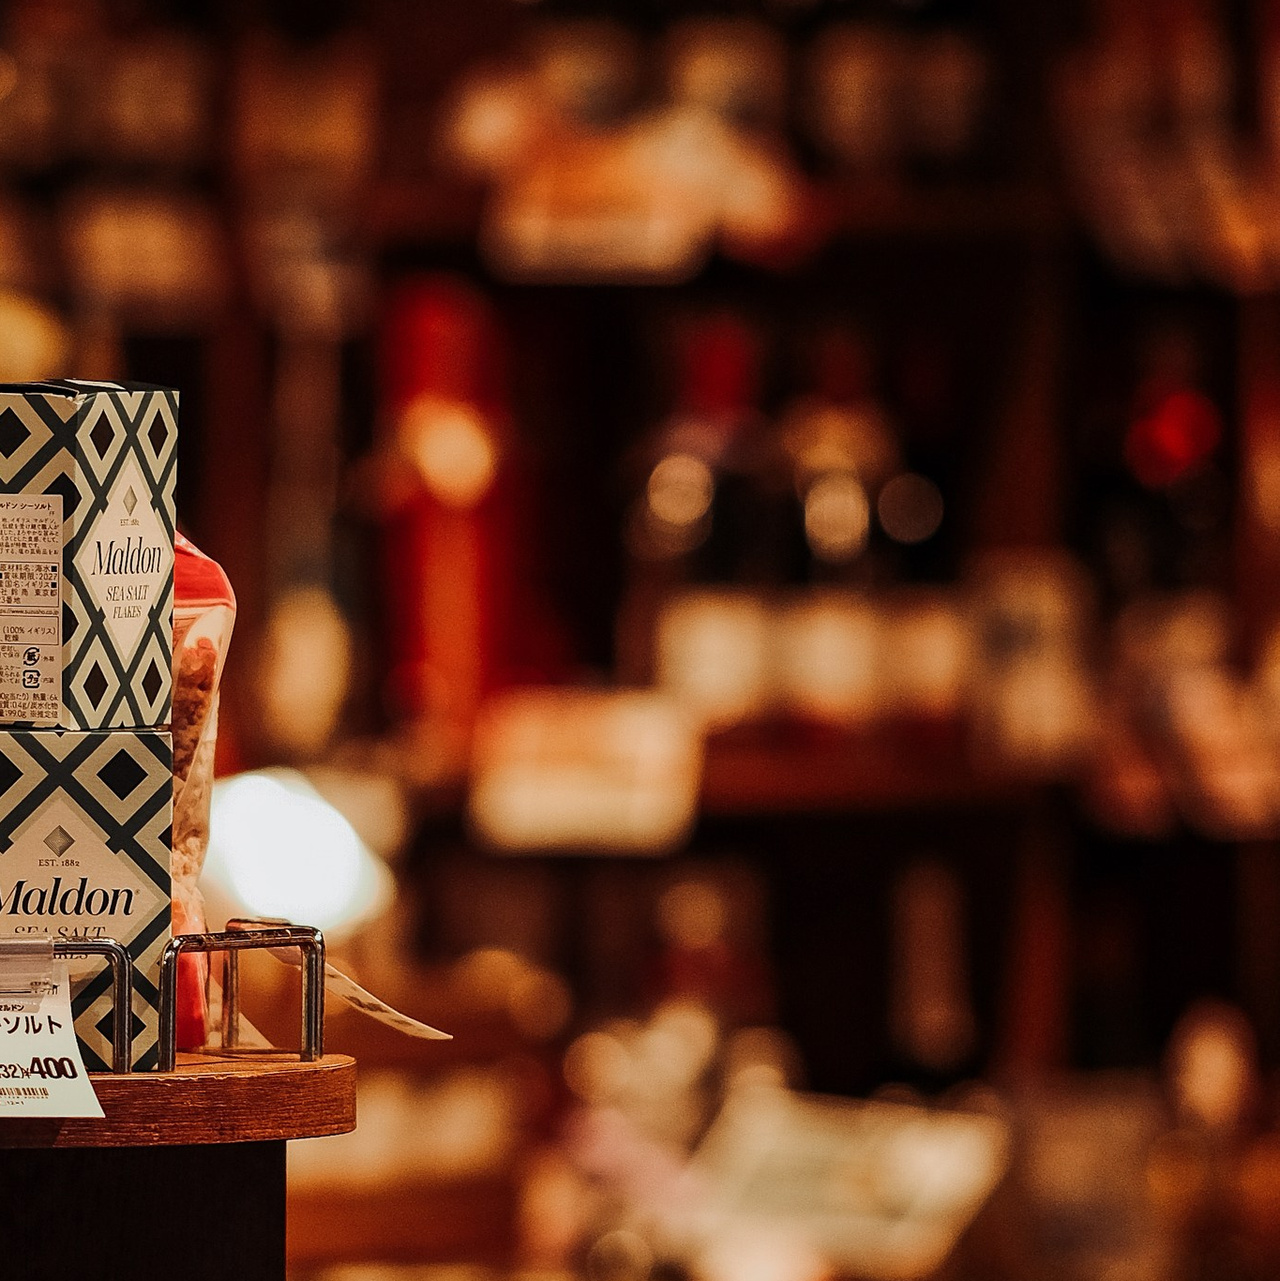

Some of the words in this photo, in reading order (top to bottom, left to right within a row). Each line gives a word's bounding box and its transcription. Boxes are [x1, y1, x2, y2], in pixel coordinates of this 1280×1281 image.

[20, 502, 53, 511] シーソルト
[91, 539, 161, 578] Maldon
[105, 585, 125, 602] SEA
[127, 585, 150, 602] SALT
[112, 606, 142, 619] FLAKES
[38, 858, 58, 867] EST.
[60, 858, 80, 867] 1882
